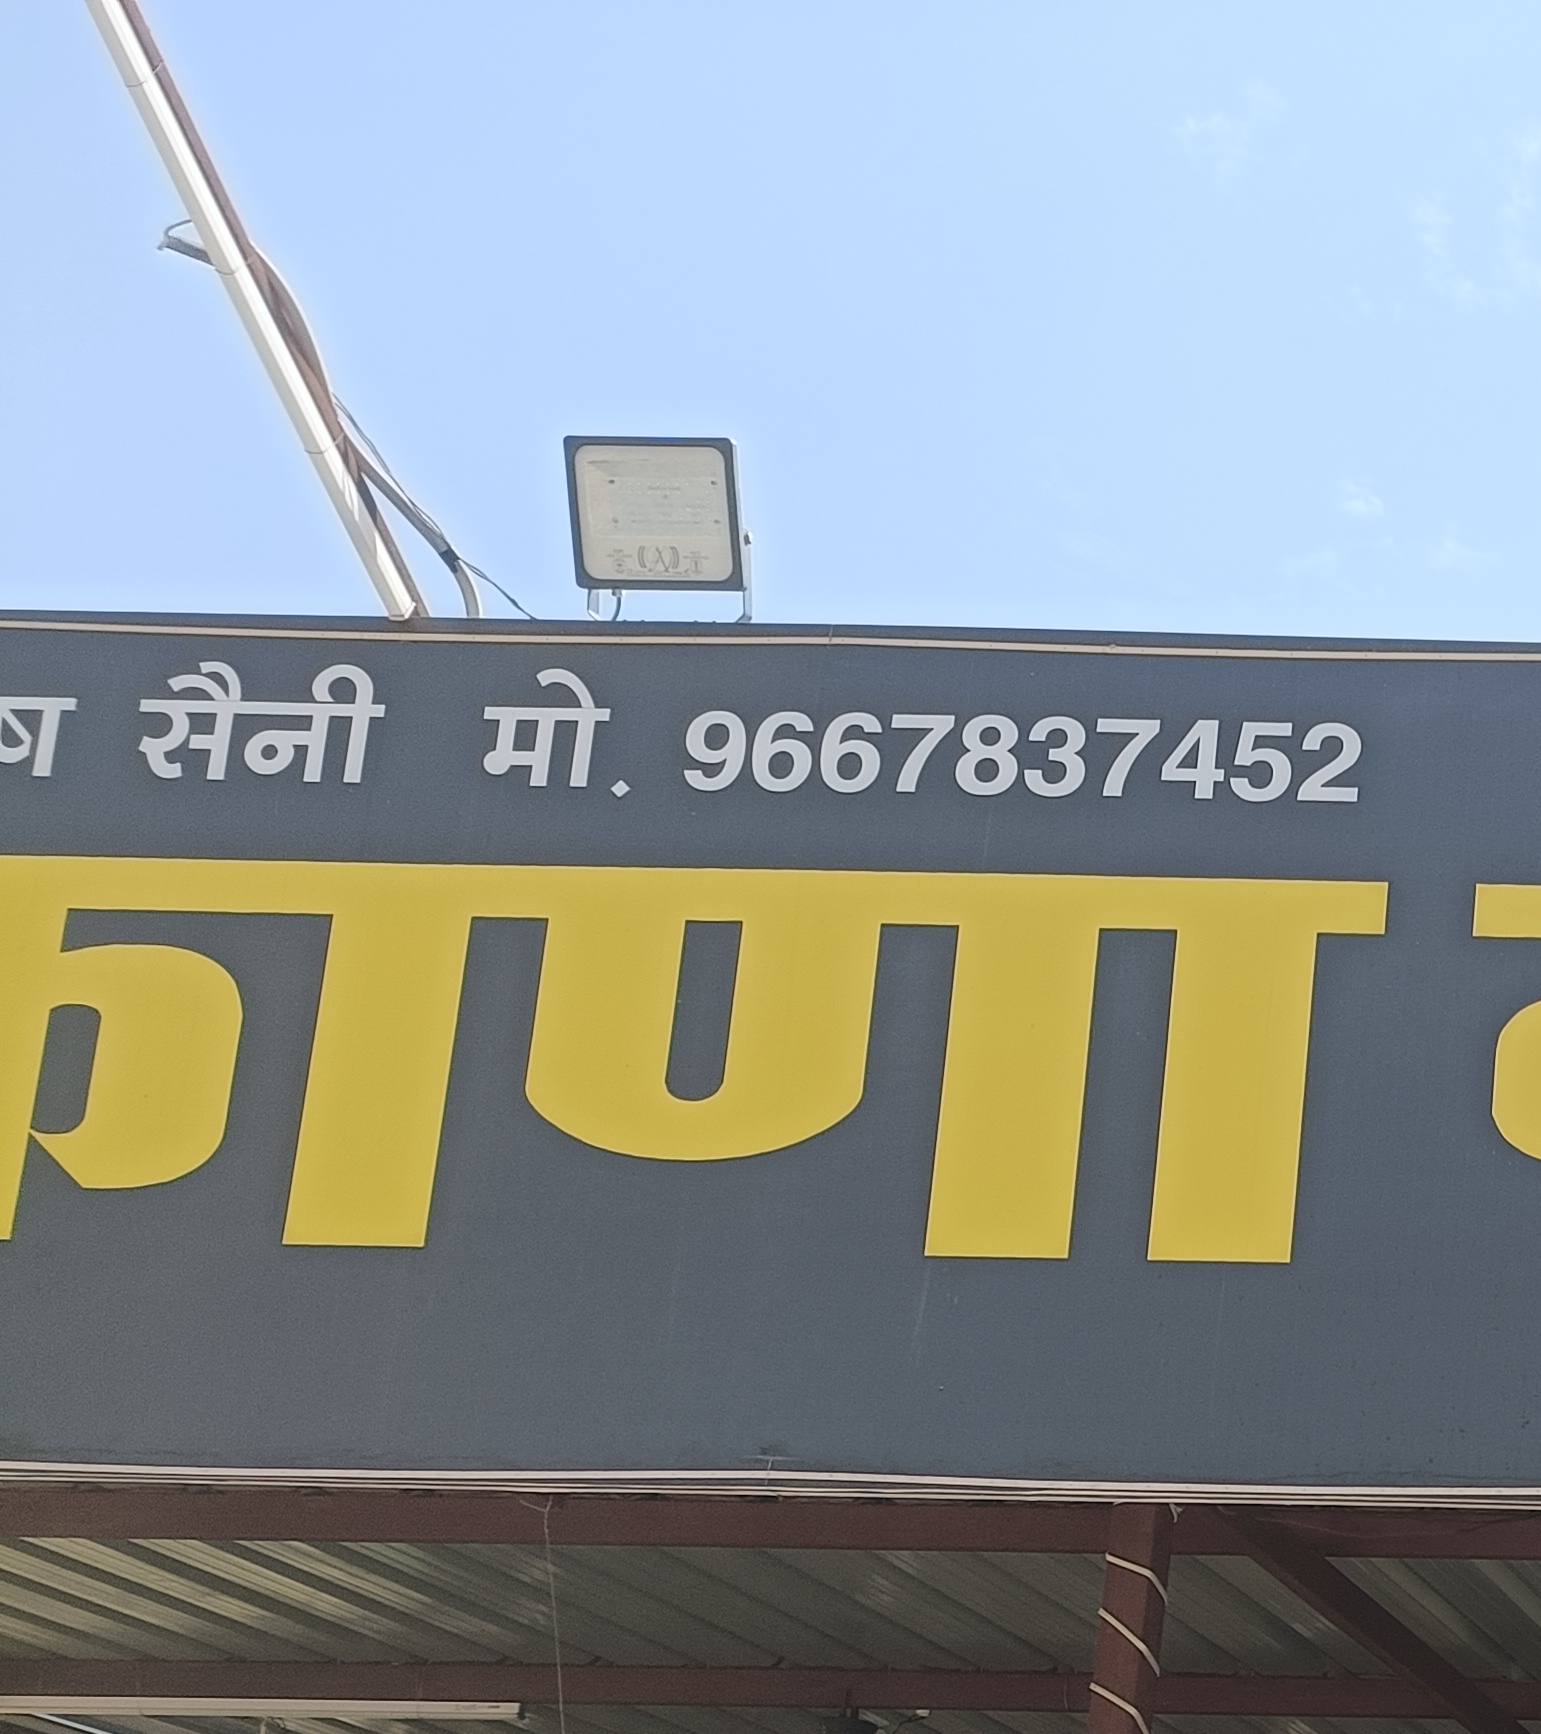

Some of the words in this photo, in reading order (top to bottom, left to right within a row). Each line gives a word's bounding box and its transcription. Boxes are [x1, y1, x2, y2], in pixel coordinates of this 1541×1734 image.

[141, 661, 385, 785] सैनी
[484, 667, 632, 798] मो.
[682, 708, 1364, 803] 9667837452
